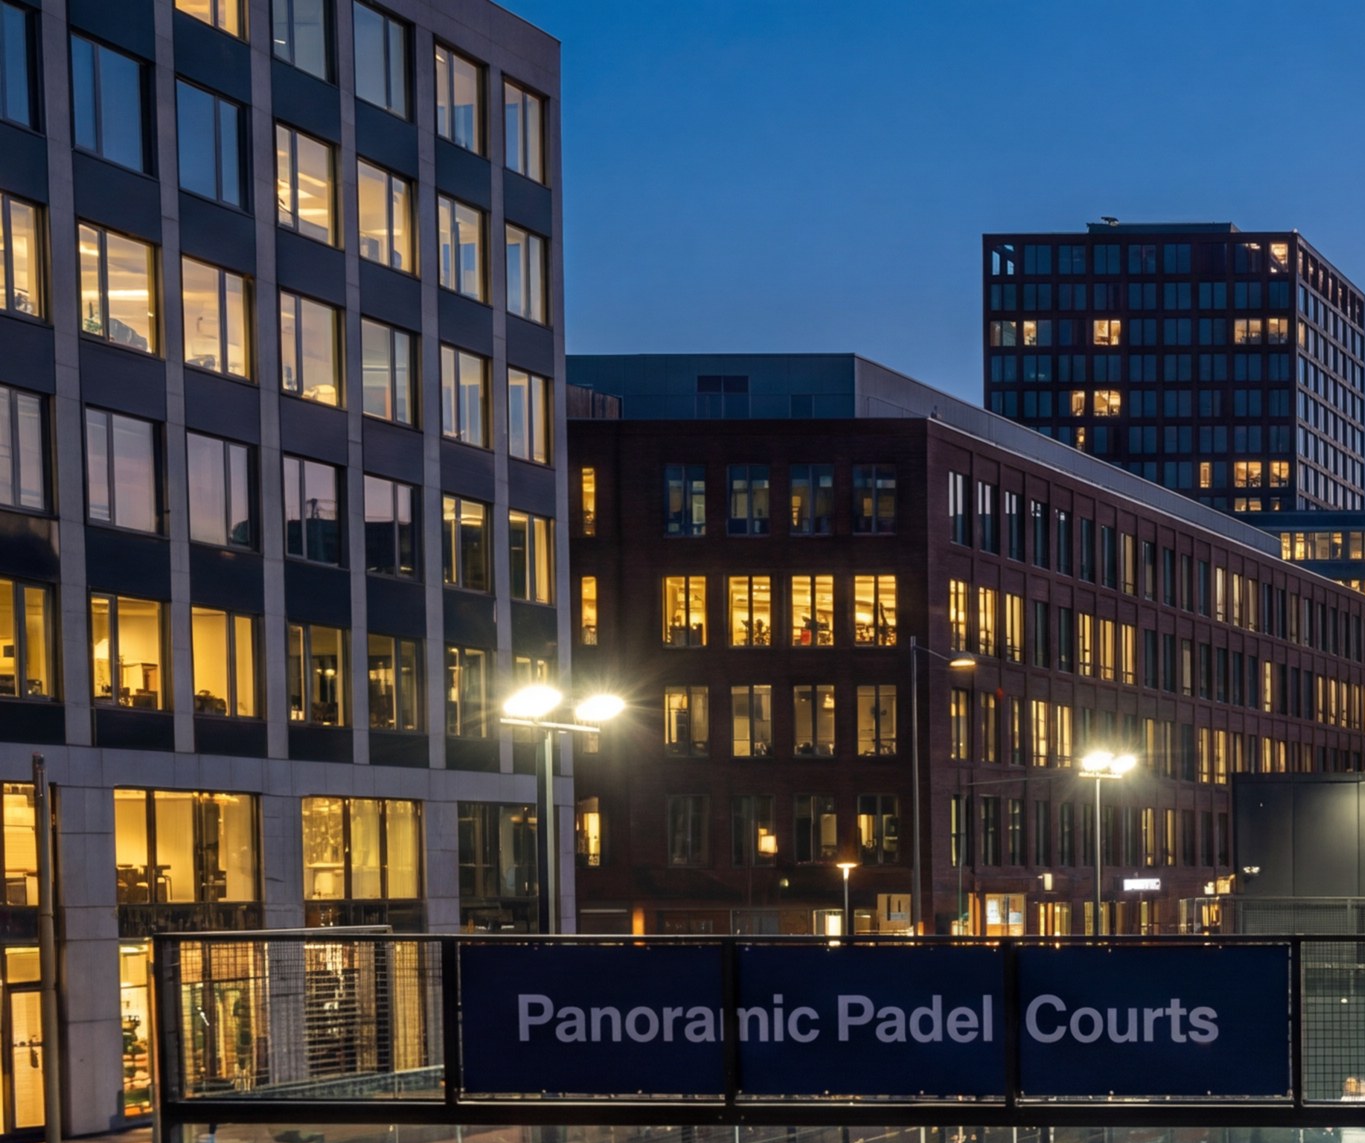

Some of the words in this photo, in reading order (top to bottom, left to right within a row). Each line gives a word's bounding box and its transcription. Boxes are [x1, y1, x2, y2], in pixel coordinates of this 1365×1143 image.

[517, 993, 821, 1044] Panoramic
[837, 993, 994, 1044] Padel
[1024, 993, 1220, 1044] Courts
